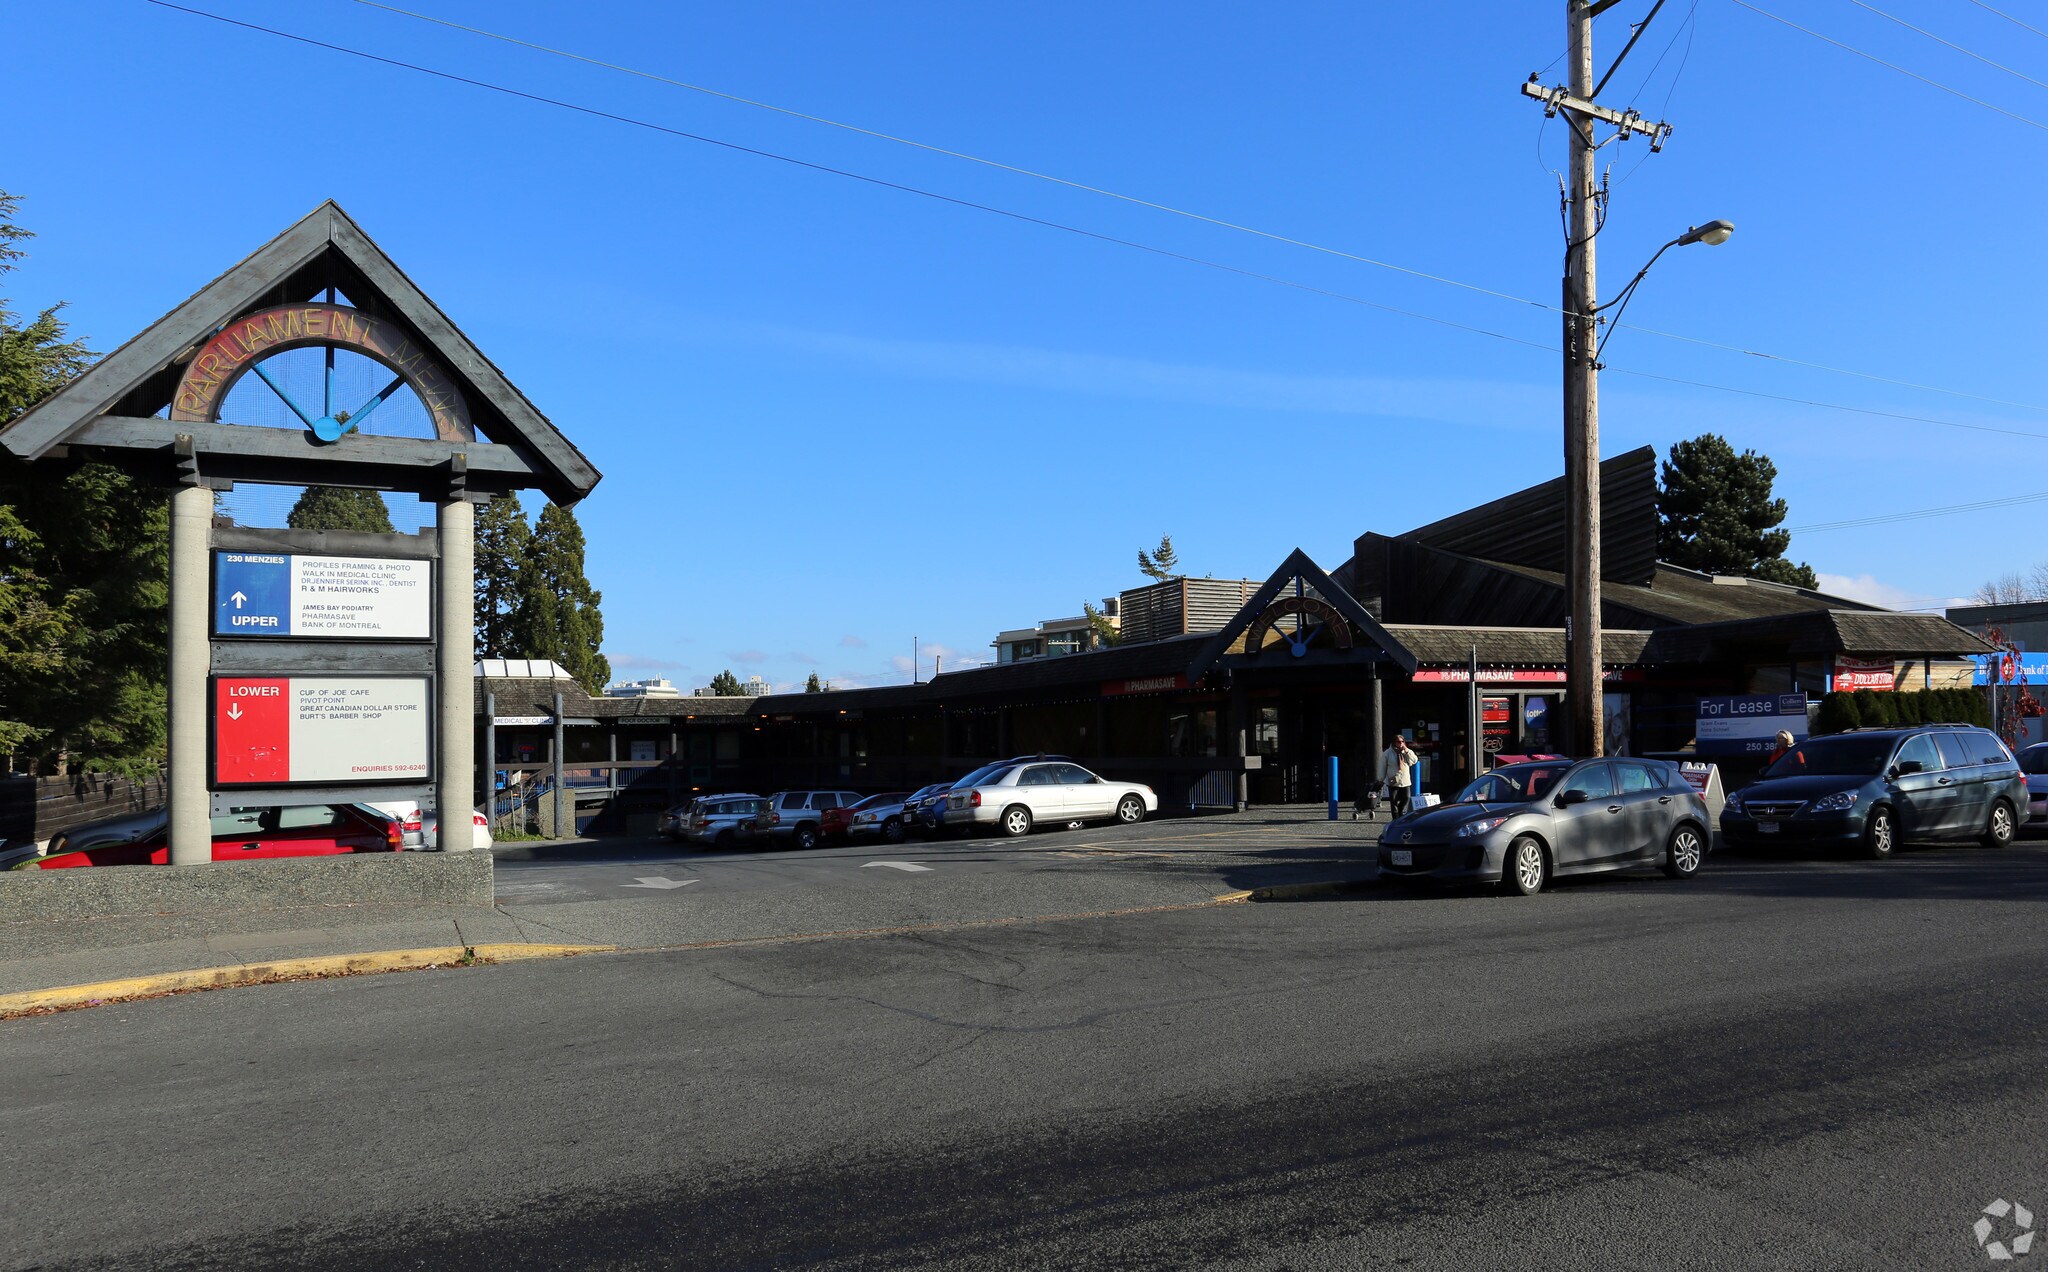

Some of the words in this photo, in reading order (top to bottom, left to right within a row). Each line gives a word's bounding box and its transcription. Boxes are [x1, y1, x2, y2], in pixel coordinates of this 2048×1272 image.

[176, 308, 378, 416] PARLIAMENT
[227, 555, 243, 563] 230
[244, 555, 285, 564] MENZIES
[302, 561, 340, 569] PROFILES
[341, 562, 376, 570] FRAMING
[336, 571, 370, 579] MEDICAL
[345, 578, 370, 586] SERINK
[327, 586, 380, 594] HAIRWORKS
[232, 615, 278, 626] UPPER
[301, 612, 356, 620] PHARMASAVE
[1250, 599, 1347, 642] WELCOME
[2037, 664, 2045, 675] of
[1451, 670, 1515, 681] PHAMASAVE
[1854, 673, 1879, 685] DOLLAR
[1130, 677, 1176, 692] PHARMASAVE
[229, 686, 280, 697] LOWER
[1700, 700, 1725, 715] For
[1730, 699, 1773, 714] Lease
[1745, 742, 1762, 751] 250
[351, 765, 393, 773] ENQUIRIES
